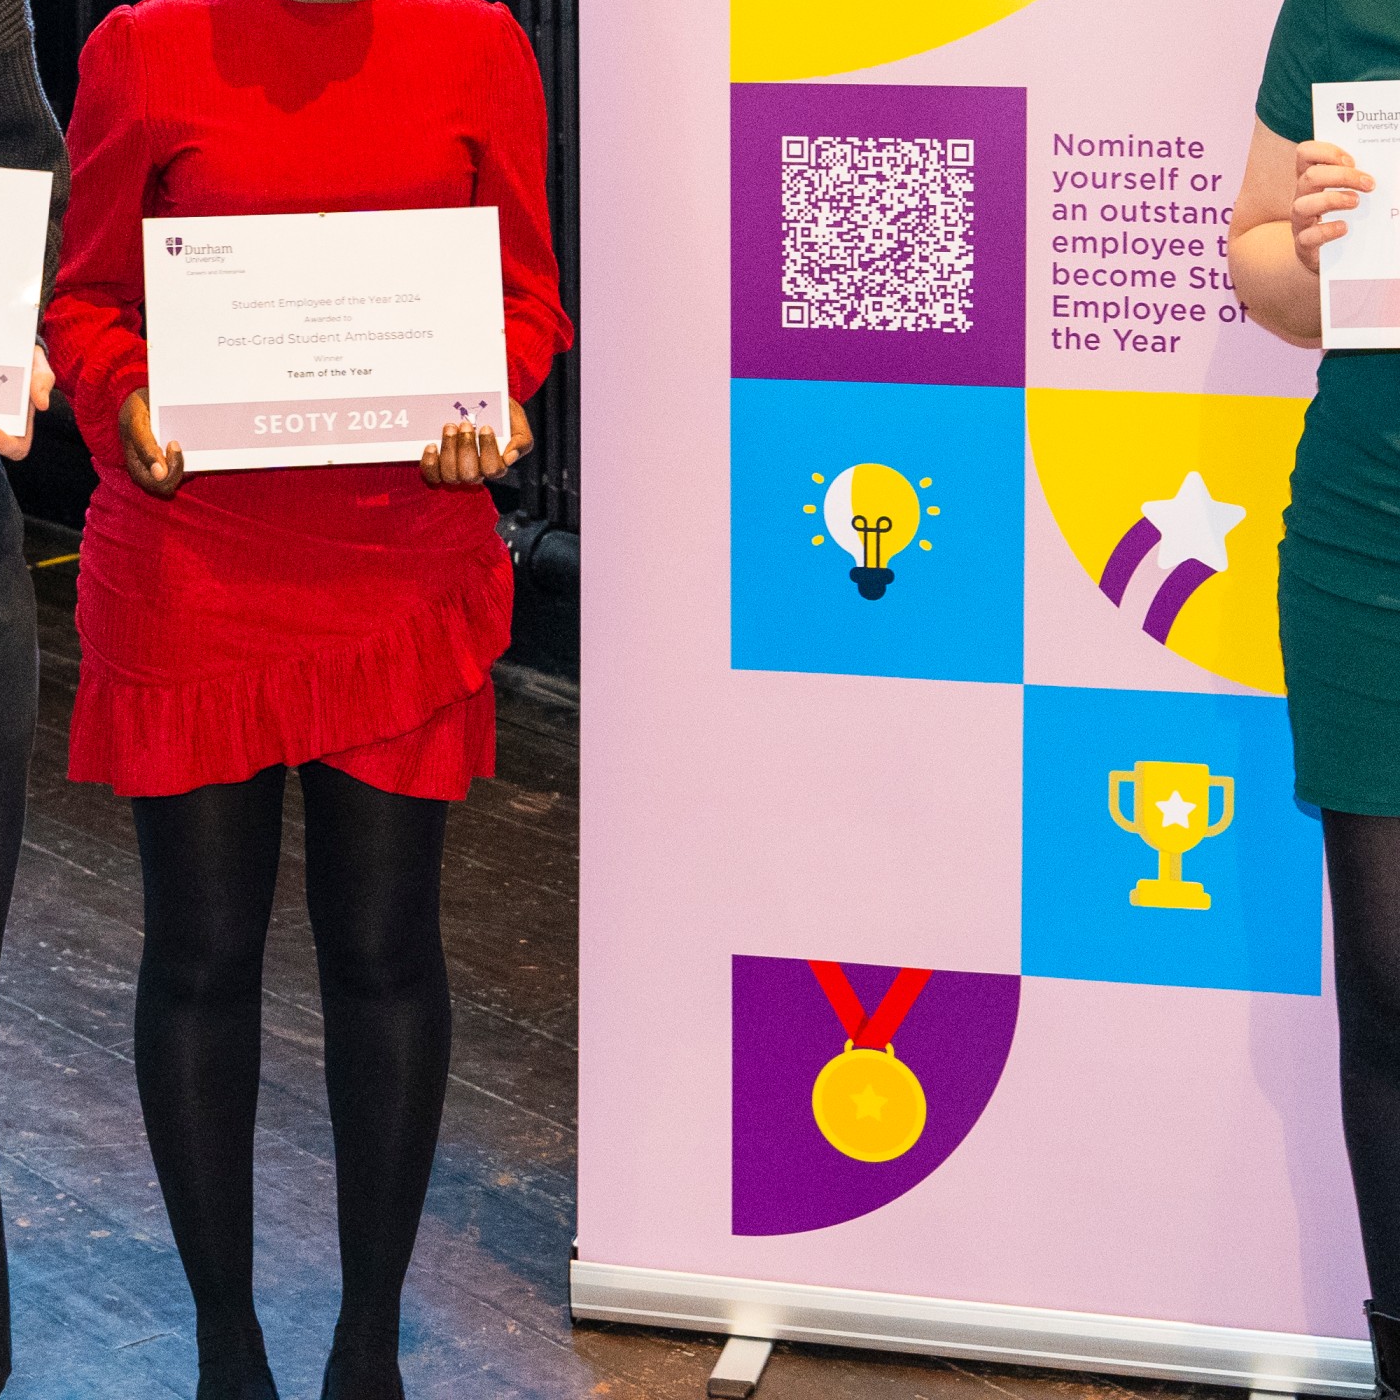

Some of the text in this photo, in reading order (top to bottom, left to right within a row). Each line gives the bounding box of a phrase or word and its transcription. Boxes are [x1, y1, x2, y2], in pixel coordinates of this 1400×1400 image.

[1053, 133, 1205, 159] Nominate
[1052, 167, 1222, 193] yourself or
[1052, 202, 1088, 222] an
[185, 244, 232, 255] Durham
[1052, 231, 1204, 260] employee
[1052, 262, 1176, 288] become
[232, 301, 275, 309] Student
[279, 299, 332, 308] Employee
[335, 296, 345, 305] of
[395, 294, 421, 303] 2024
[1052, 295, 1249, 325] Employee of
[218, 329, 433, 346] Post-Grad Student Ambassadors
[1052, 326, 1181, 353] the Year
[318, 369, 327, 377] of
[254, 410, 409, 434] SEOTY 2024
